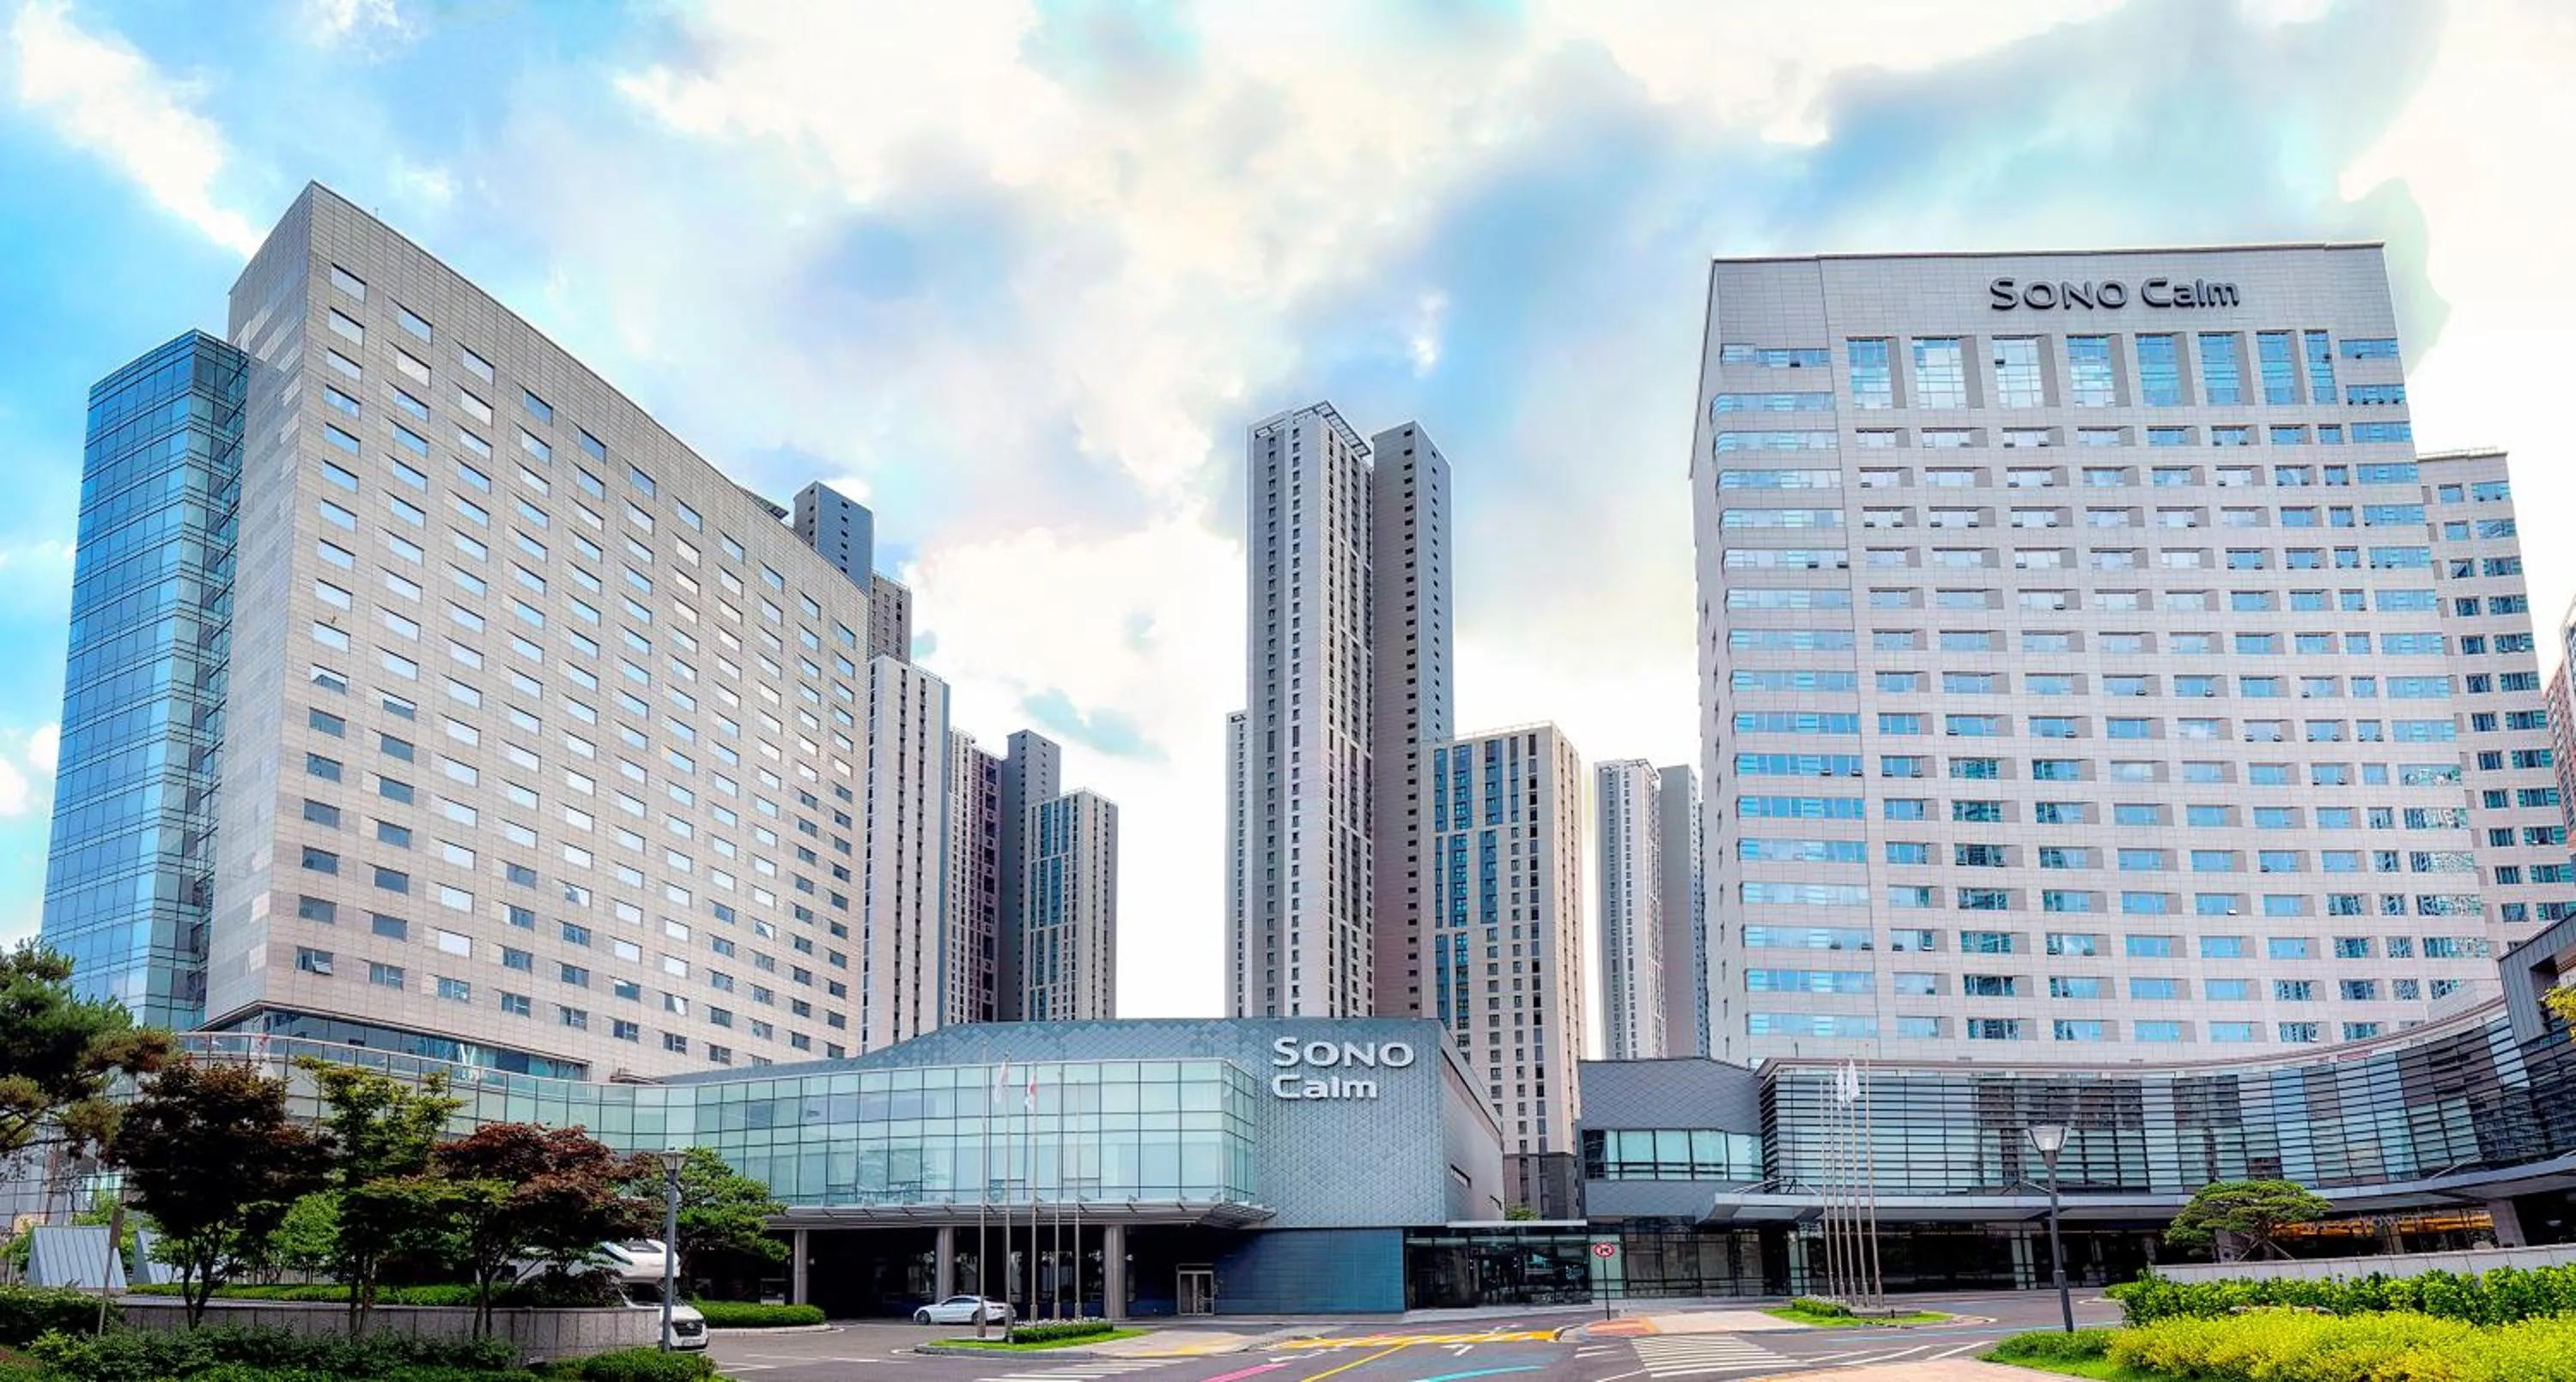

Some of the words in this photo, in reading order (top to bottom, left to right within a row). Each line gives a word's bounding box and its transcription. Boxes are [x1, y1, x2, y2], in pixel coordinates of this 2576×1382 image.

[1990, 276, 2129, 311] SONO
[2141, 276, 2240, 308] Calm
[1272, 1035, 1416, 1069] SONO
[1272, 1074, 1379, 1100] Calm
